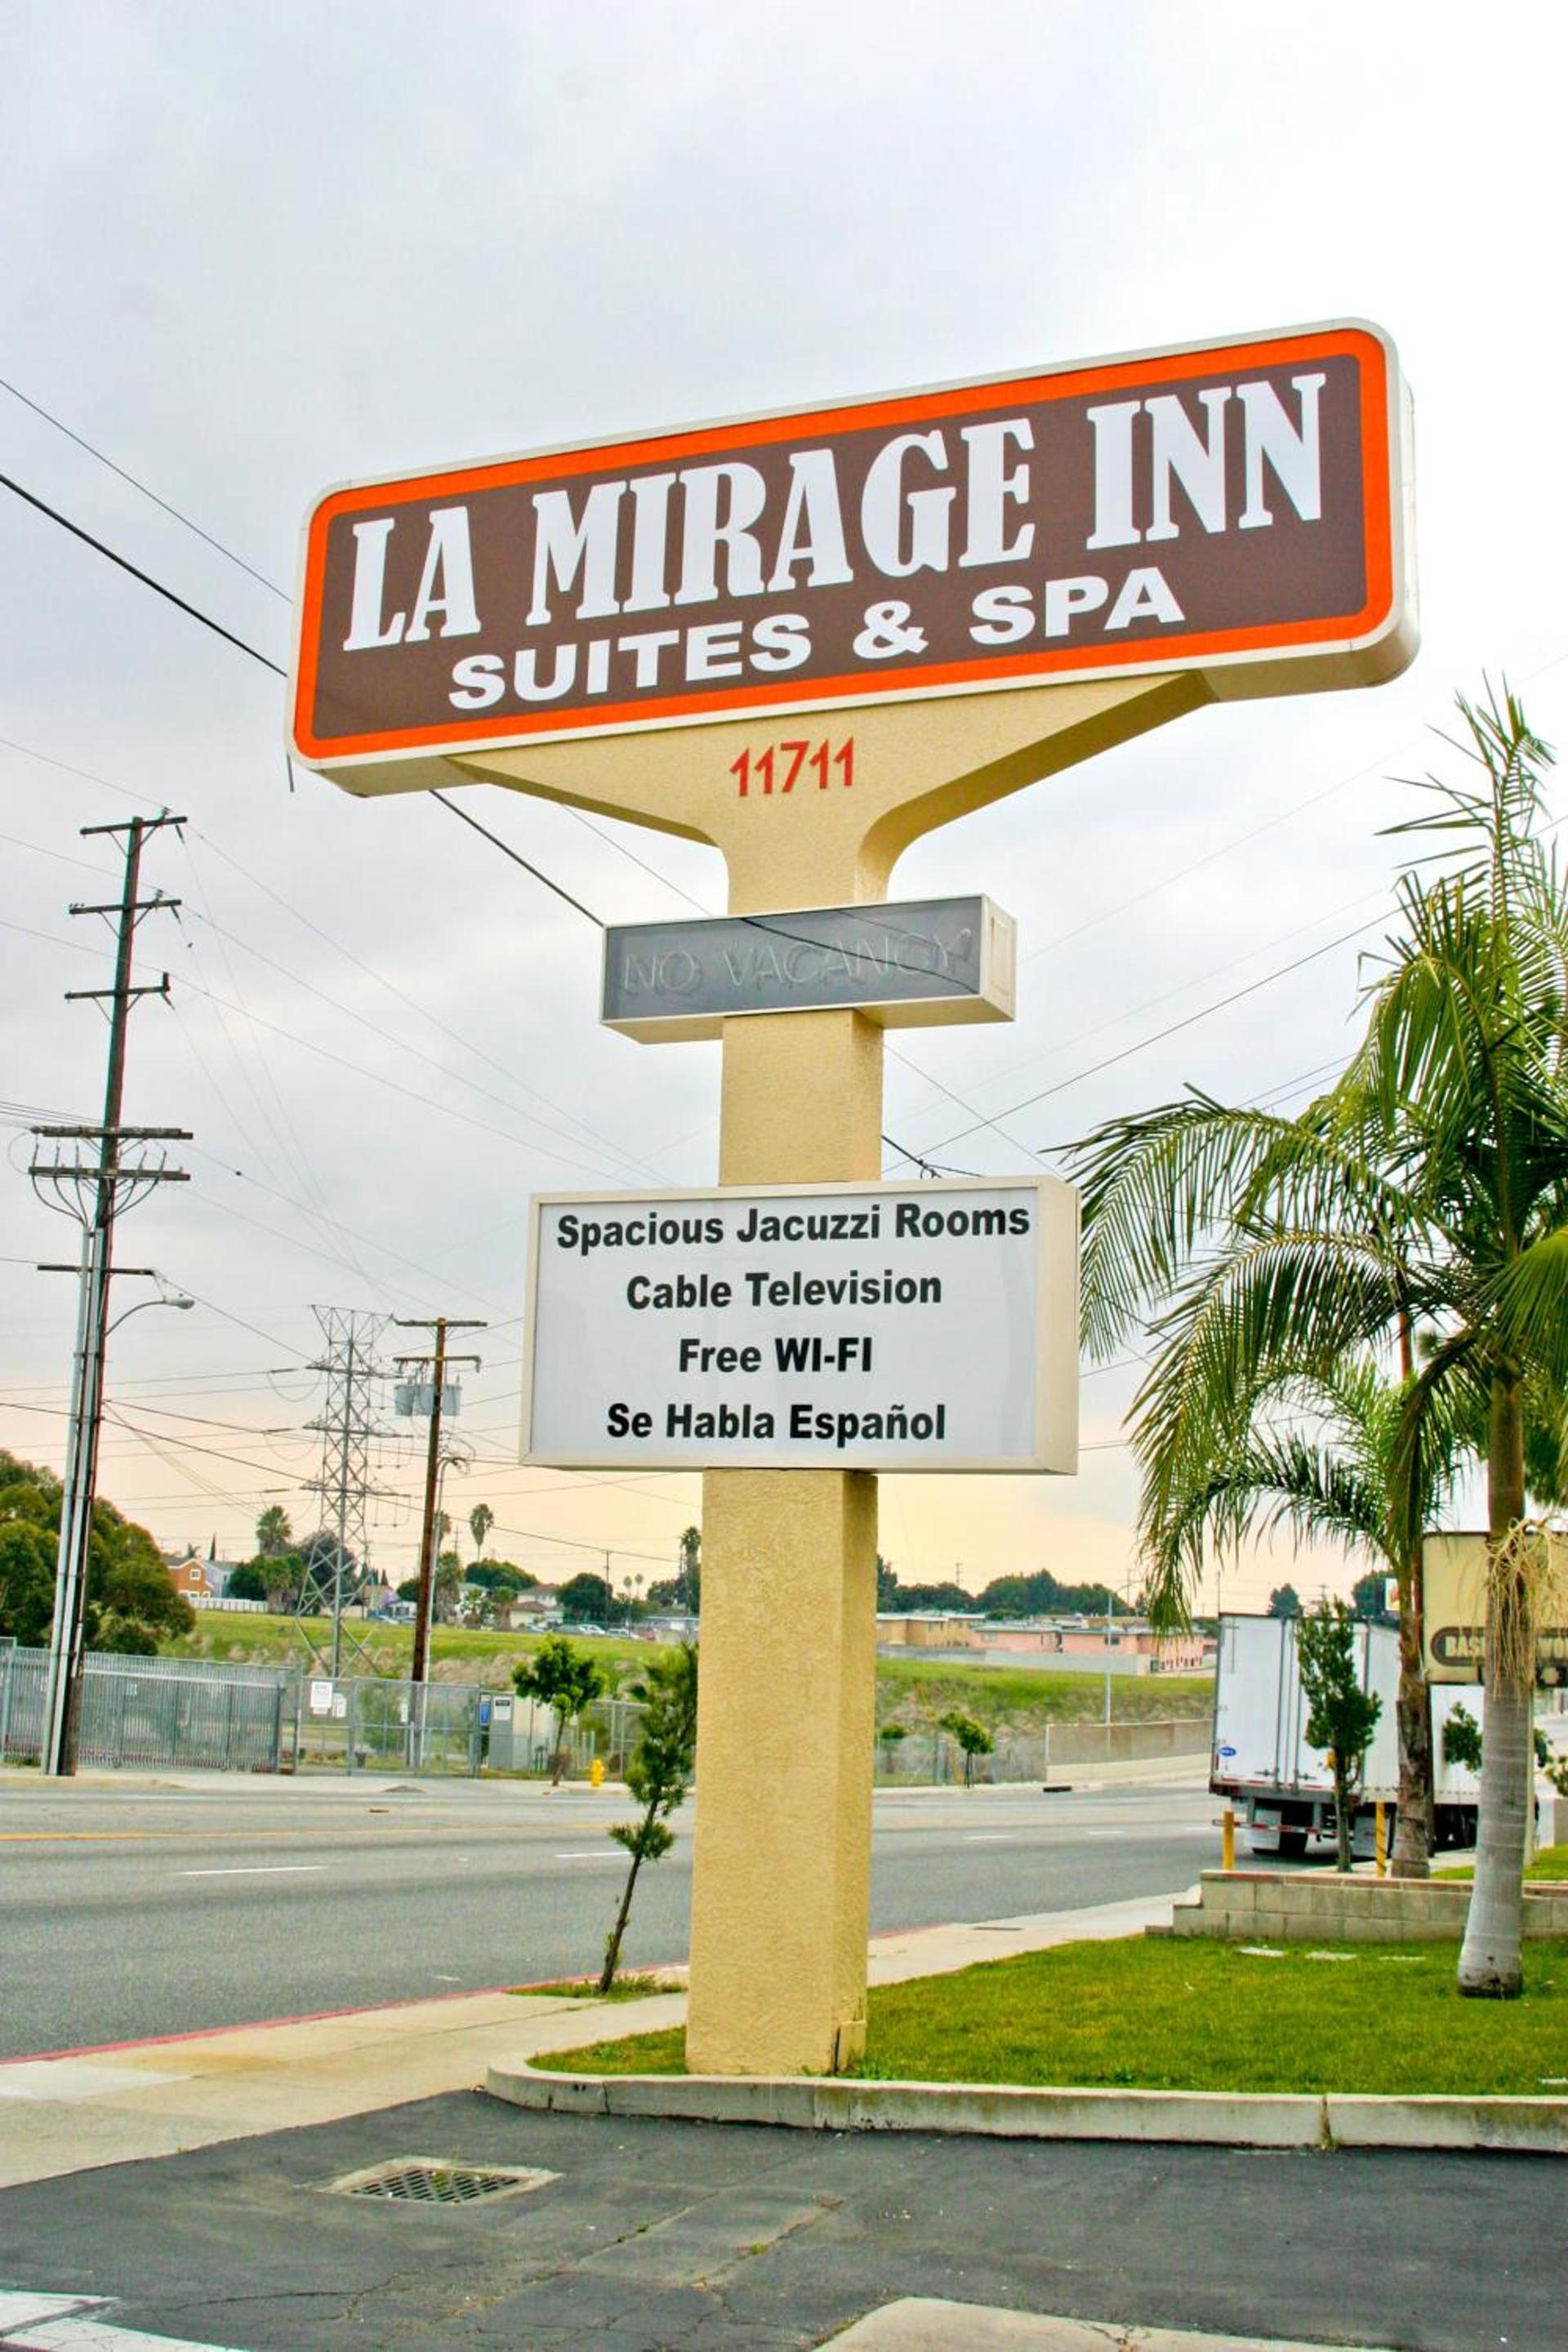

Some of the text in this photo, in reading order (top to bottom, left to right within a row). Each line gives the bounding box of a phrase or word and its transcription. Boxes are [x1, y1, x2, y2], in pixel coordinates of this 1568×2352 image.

[343, 372, 1326, 652] LA MIRAGE INN
[448, 567, 1186, 710] SUITES & SPA
[729, 737, 854, 797] 11711
[623, 928, 972, 991] NO VACANCY
[557, 1203, 1030, 1256] Spacious Jacuzzi Rooms
[626, 1269, 942, 1310] Cable Television
[679, 1337, 872, 1373] Free WI-FI
[607, 1402, 946, 1449] Se Habla Español
